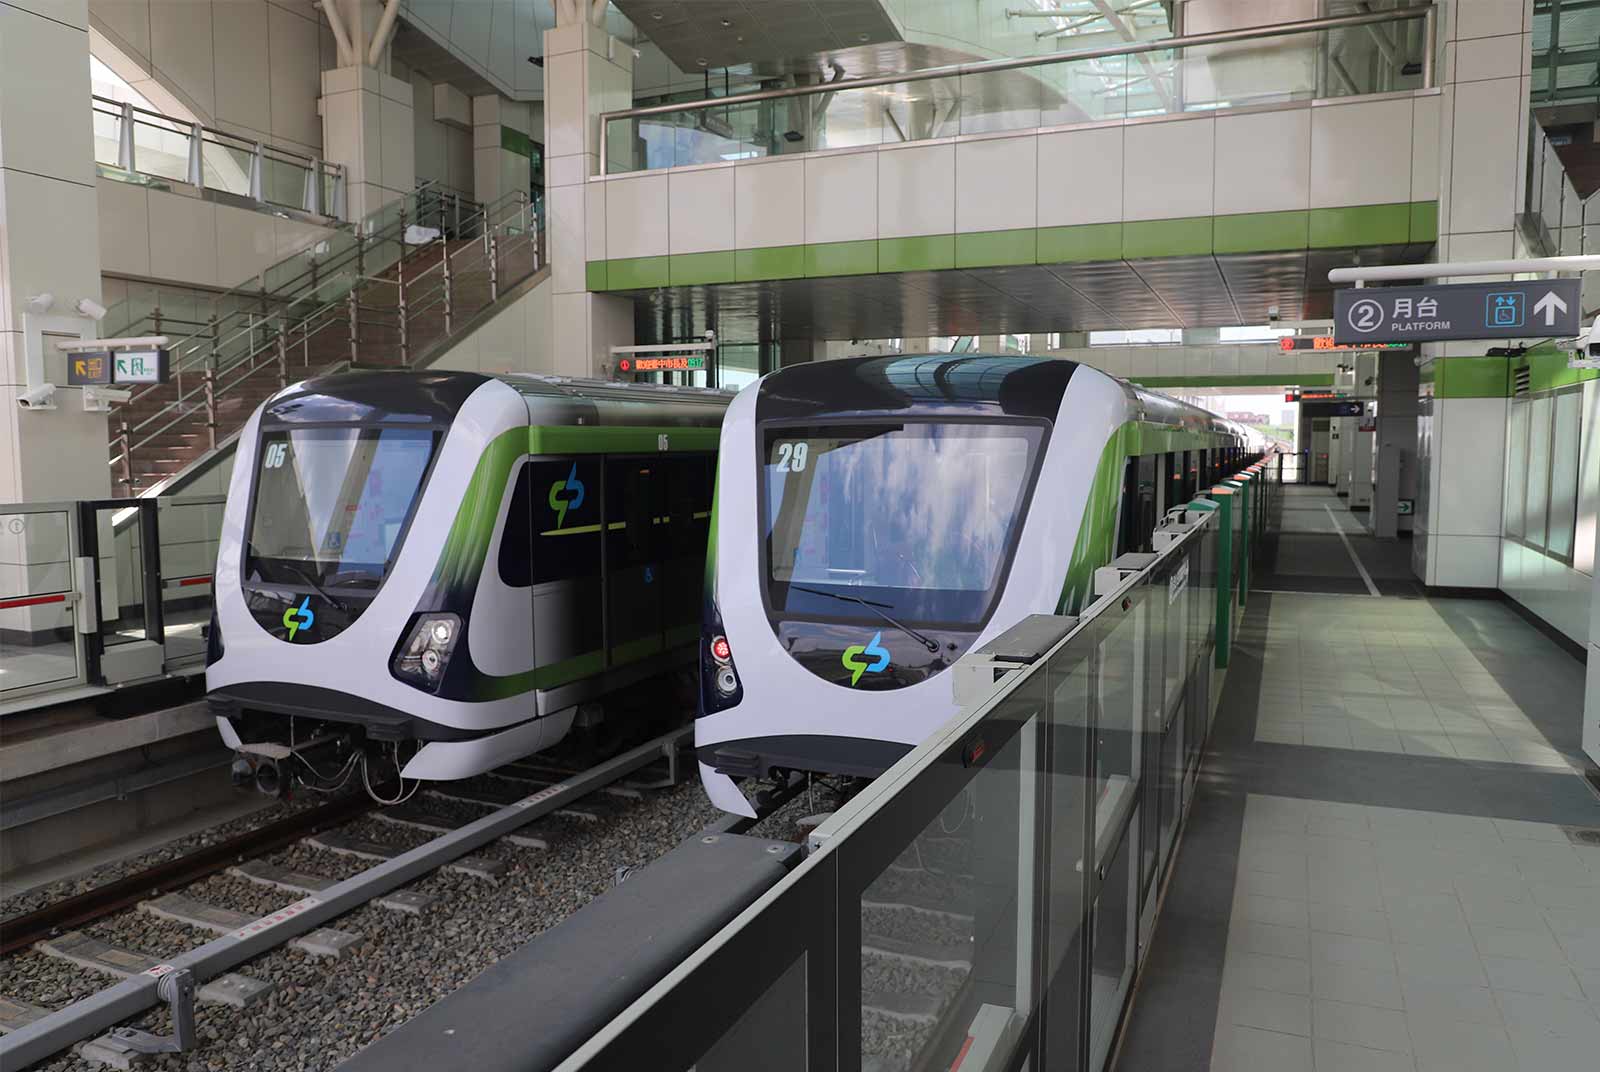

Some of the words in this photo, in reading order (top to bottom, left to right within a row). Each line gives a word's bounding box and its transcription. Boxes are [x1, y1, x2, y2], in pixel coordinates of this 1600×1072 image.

[1392, 296, 1439, 319] 月台
[1391, 321, 1451, 331] PLATFORM
[657, 434, 669, 451] 05
[265, 443, 288, 468] 05
[776, 442, 809, 473] 29
